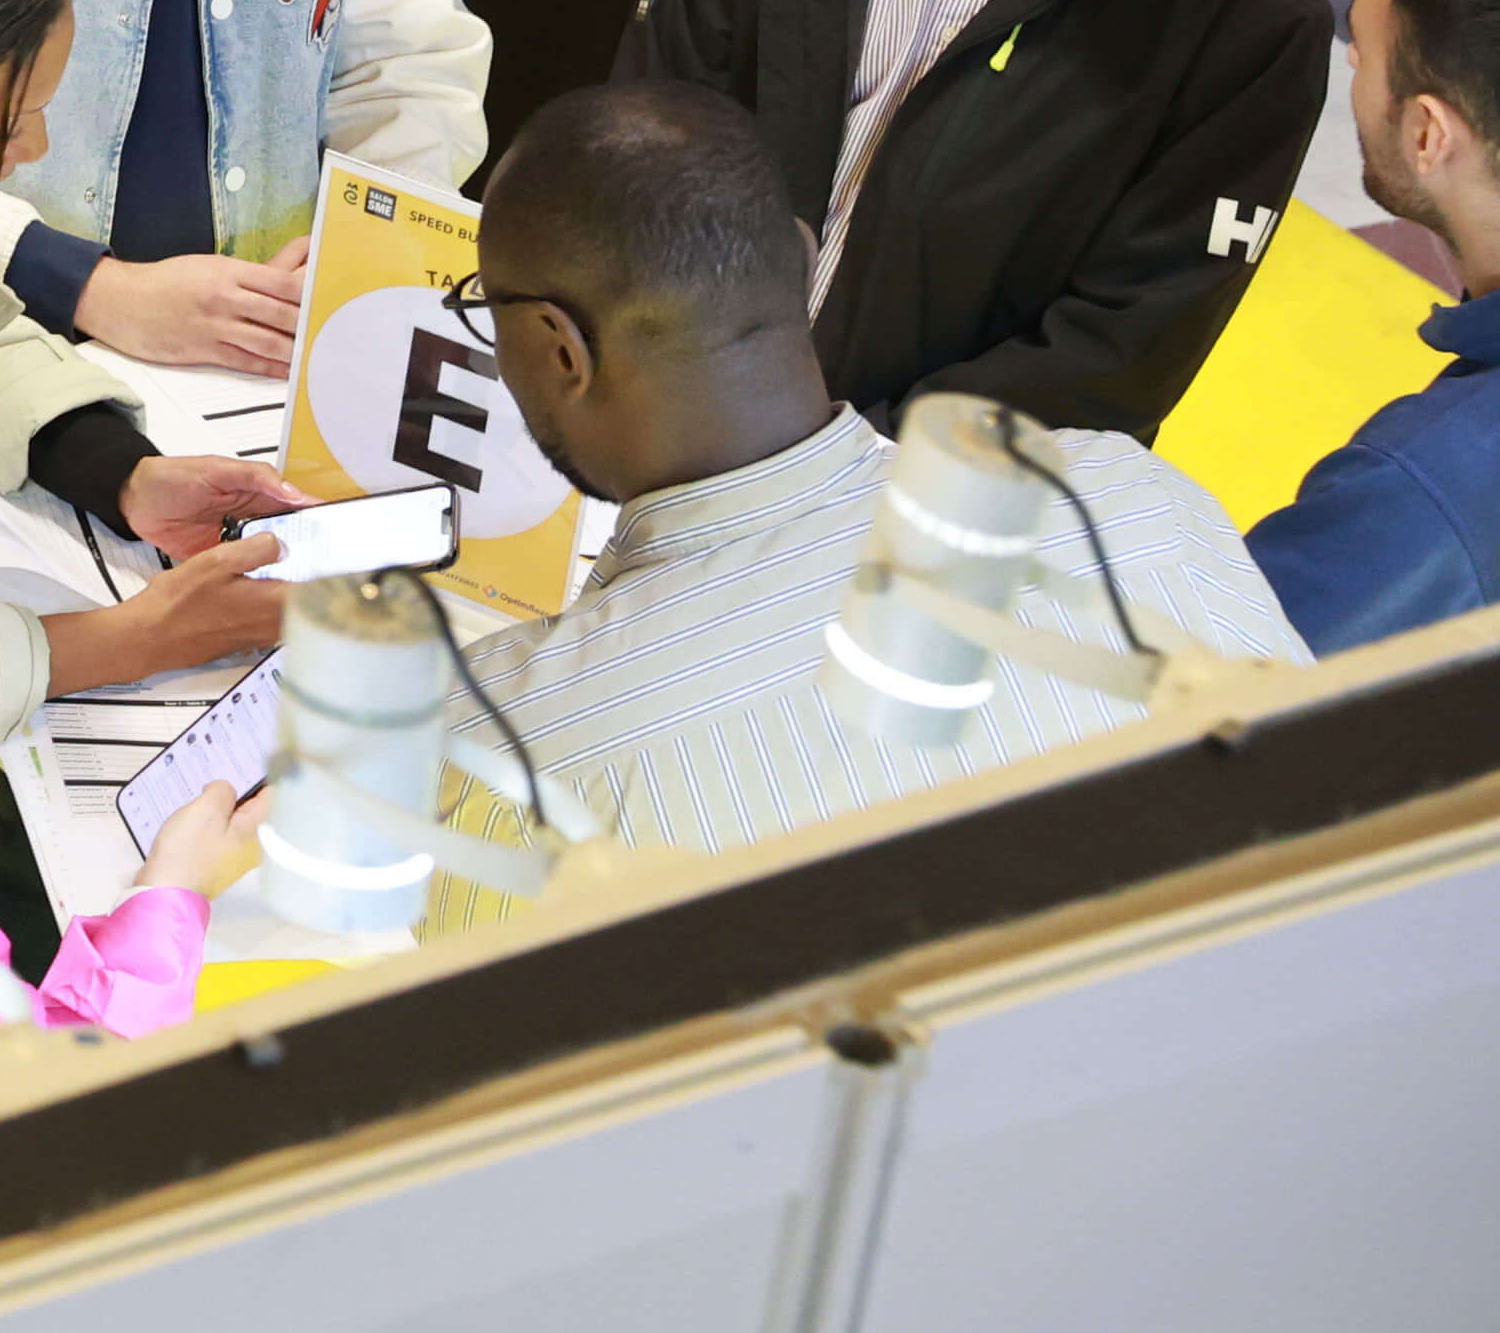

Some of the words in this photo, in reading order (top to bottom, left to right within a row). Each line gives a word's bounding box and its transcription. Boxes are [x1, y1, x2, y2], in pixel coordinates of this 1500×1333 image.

[368, 190, 395, 204] SALON
[366, 200, 393, 218] SME
[409, 211, 454, 234] SPEED
[392, 326, 501, 494] E
